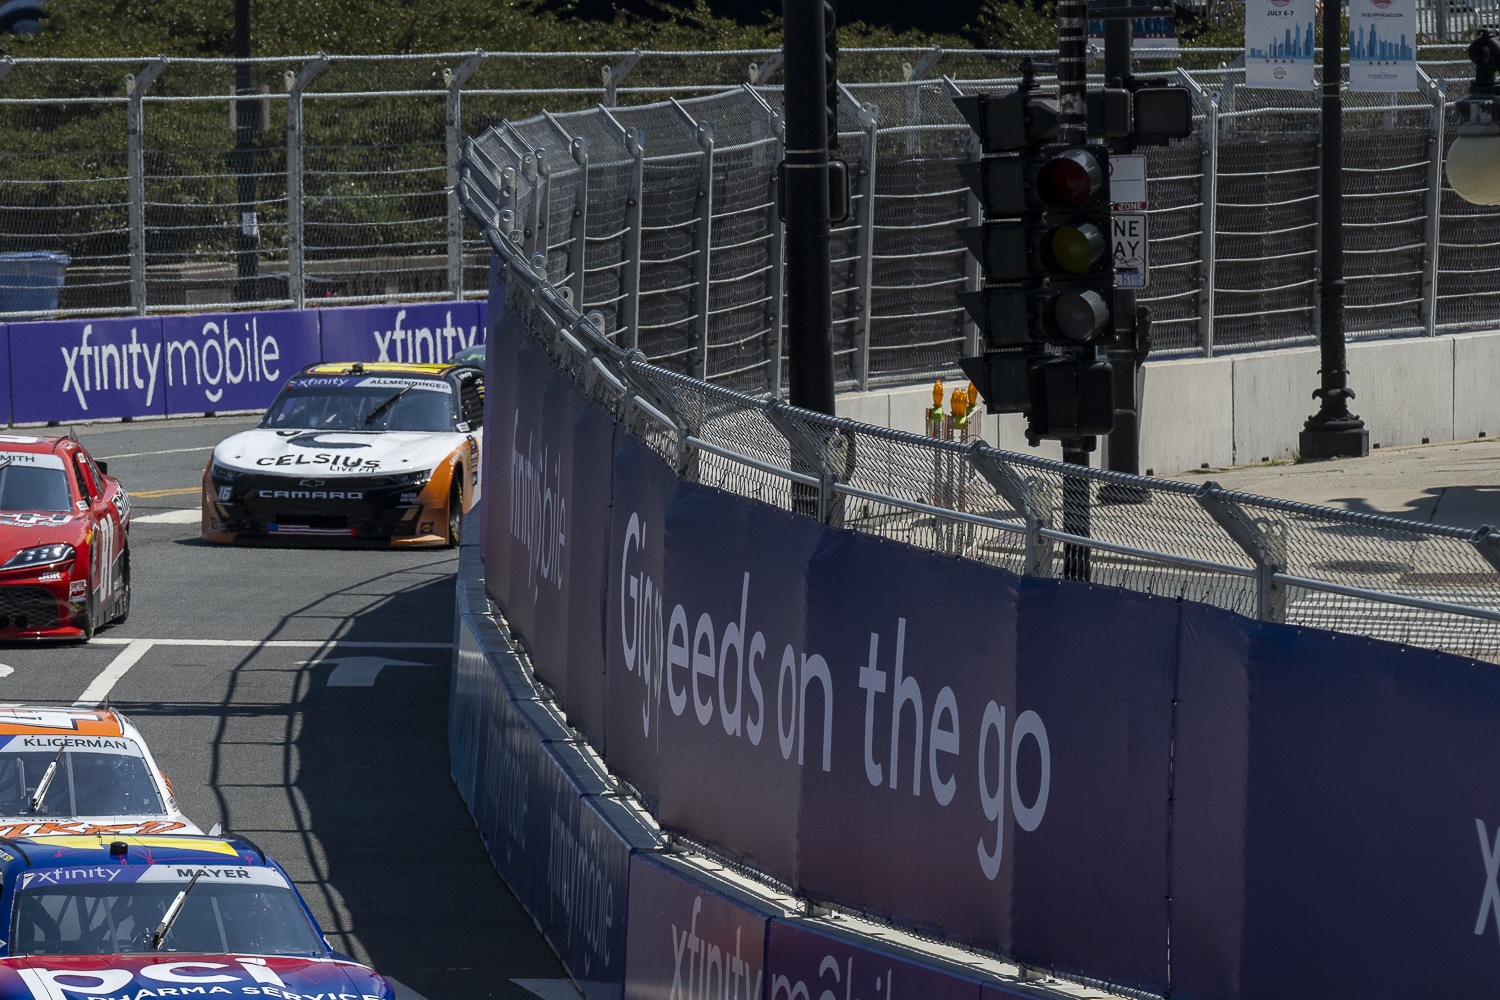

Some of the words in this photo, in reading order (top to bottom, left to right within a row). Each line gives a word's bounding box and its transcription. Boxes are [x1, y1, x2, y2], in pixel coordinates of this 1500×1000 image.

[1120, 202, 1143, 210] ZONE
[1114, 220, 1139, 237] NE
[1113, 240, 1140, 257] AY
[61, 324, 161, 411] xfinity
[167, 317, 280, 403] môbile
[298, 378, 349, 387] xfinity
[369, 378, 449, 390] ALLMENDINGER
[256, 454, 380, 468] CELSIUS
[217, 485, 234, 501] 16
[260, 490, 363, 500] CAMARO
[23, 738, 128, 750] KLIGERMAN
[777, 643, 834, 772] on
[858, 617, 960, 807] the
[977, 700, 1051, 881] go
[36, 866, 122, 884] xfinity
[176, 867, 251, 880] MAYER
